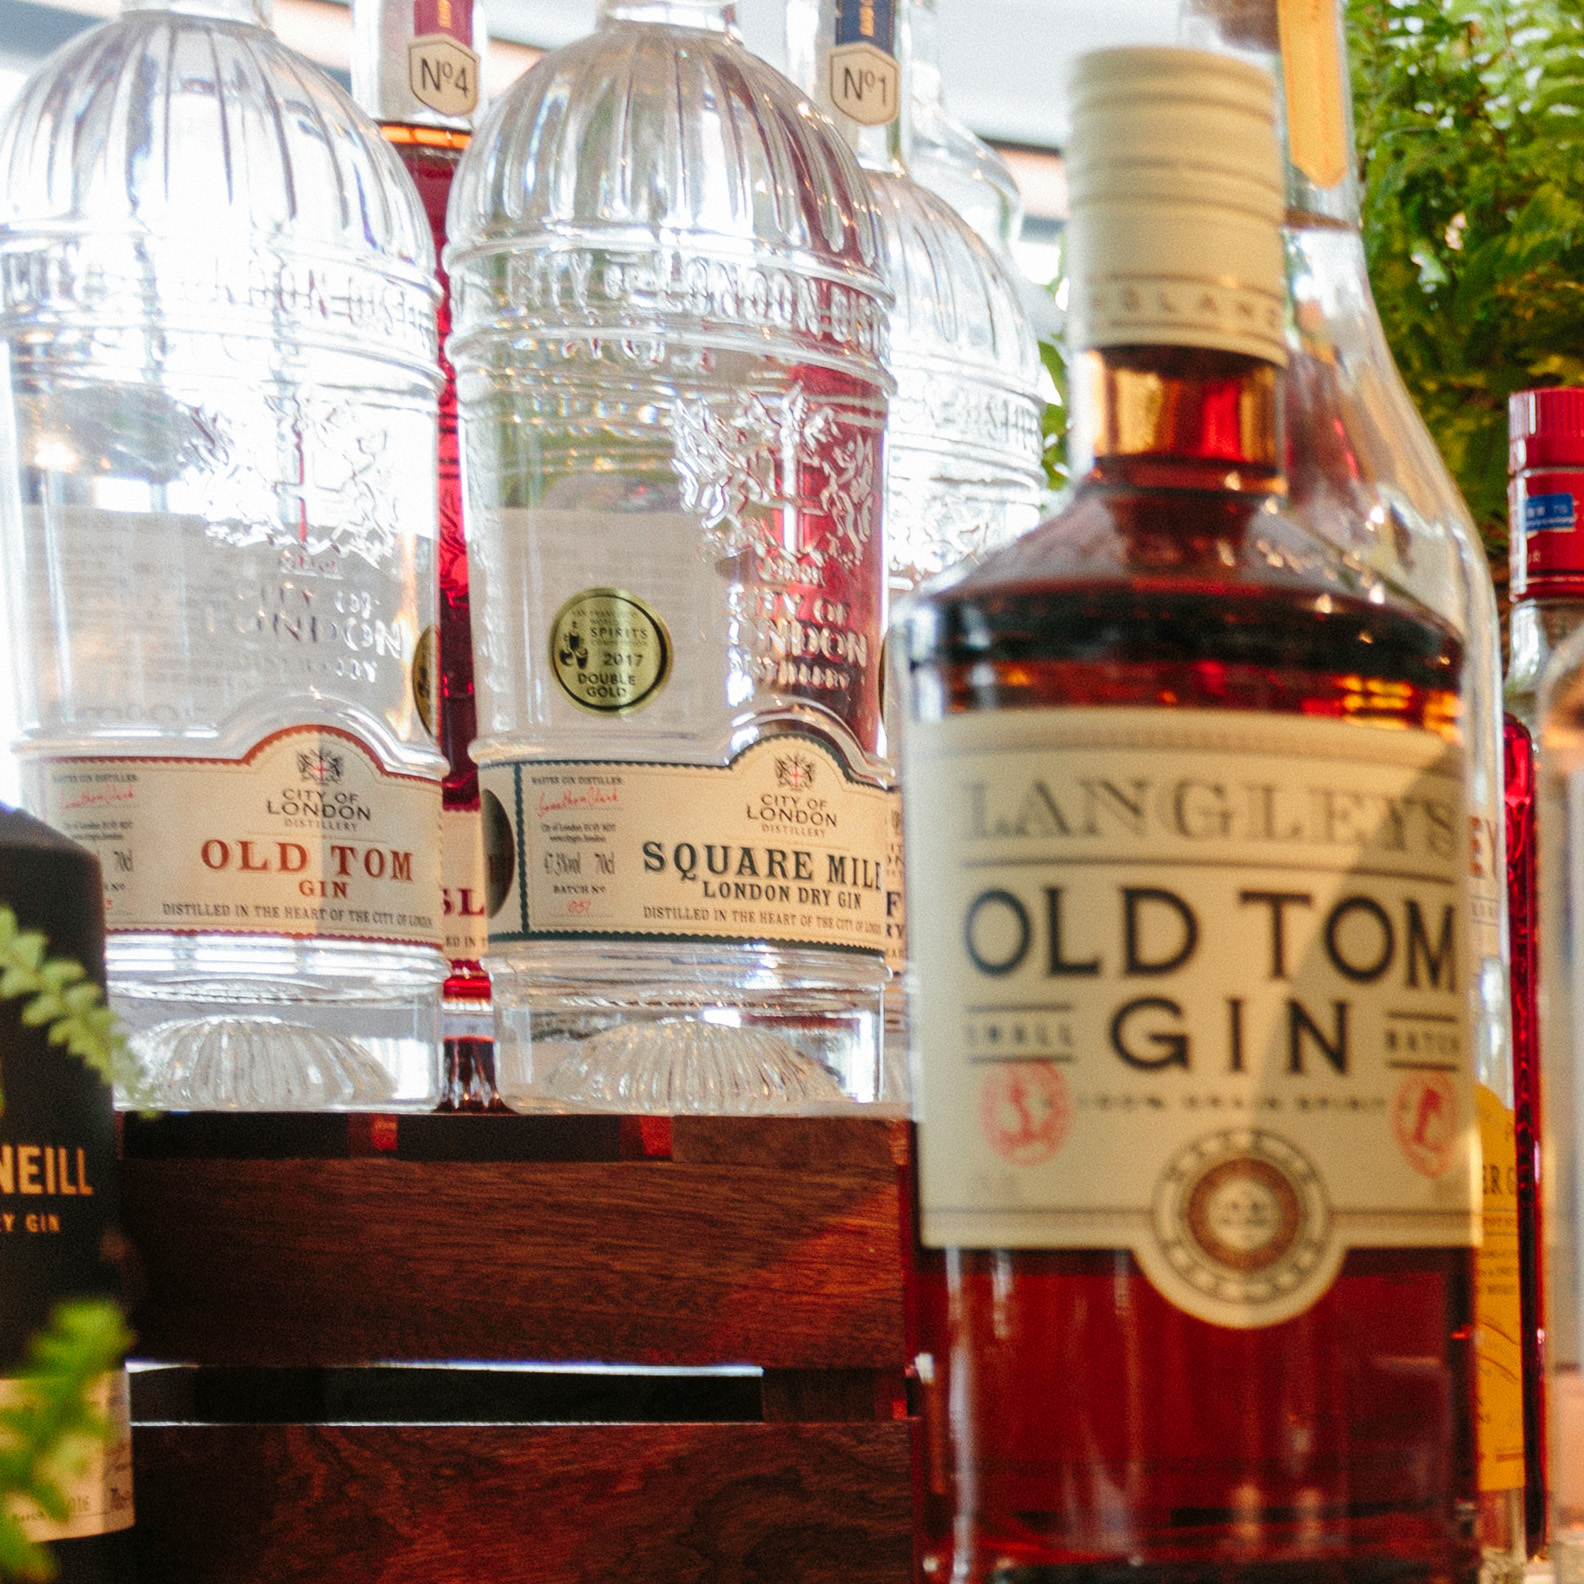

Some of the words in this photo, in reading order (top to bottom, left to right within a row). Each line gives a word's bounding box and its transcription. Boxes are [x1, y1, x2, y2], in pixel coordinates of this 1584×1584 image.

[589, 626, 649, 641] SPIRITS
[603, 653, 645, 667] 2017
[577, 672, 637, 687] DOUBLE
[586, 686, 627, 699] GOLD
[282, 787, 327, 802] CITY
[334, 790, 359, 804] OF
[760, 793, 799, 809] CITY
[807, 798, 828, 811] OF
[266, 799, 371, 822] LONDON
[745, 804, 838, 828] LONDON
[283, 818, 358, 833] DISTILLERY
[761, 823, 826, 838] DISTILLERY
[201, 838, 311, 873] OLD
[330, 844, 414, 882] TOM
[642, 840, 815, 882] SQUARE
[298, 879, 348, 900] GIN
[553, 884, 589, 895] BATCH
[702, 880, 791, 902] LONDON
[798, 886, 832, 906] DRY
[837, 890, 862, 910] GIN
[162, 902, 232, 918] DISTILLED
[235, 904, 249, 918] IN
[254, 904, 280, 919] THE
[284, 906, 326, 922] HEART
[329, 908, 346, 923] OF
[348, 910, 371, 924] THE
[372, 911, 395, 926] CITY
[643, 905, 710, 921] DISTILLED
[714, 908, 727, 922] IN
[732, 909, 756, 924] THE
[759, 911, 797, 926] HEART
[800, 914, 813, 928] OF
[816, 915, 835, 930] THE
[835, 917, 854, 931] CITY
[963, 884, 1200, 978] OLD
[1239, 889, 1457, 993] TOM
[1109, 995, 1350, 1076] GIN
